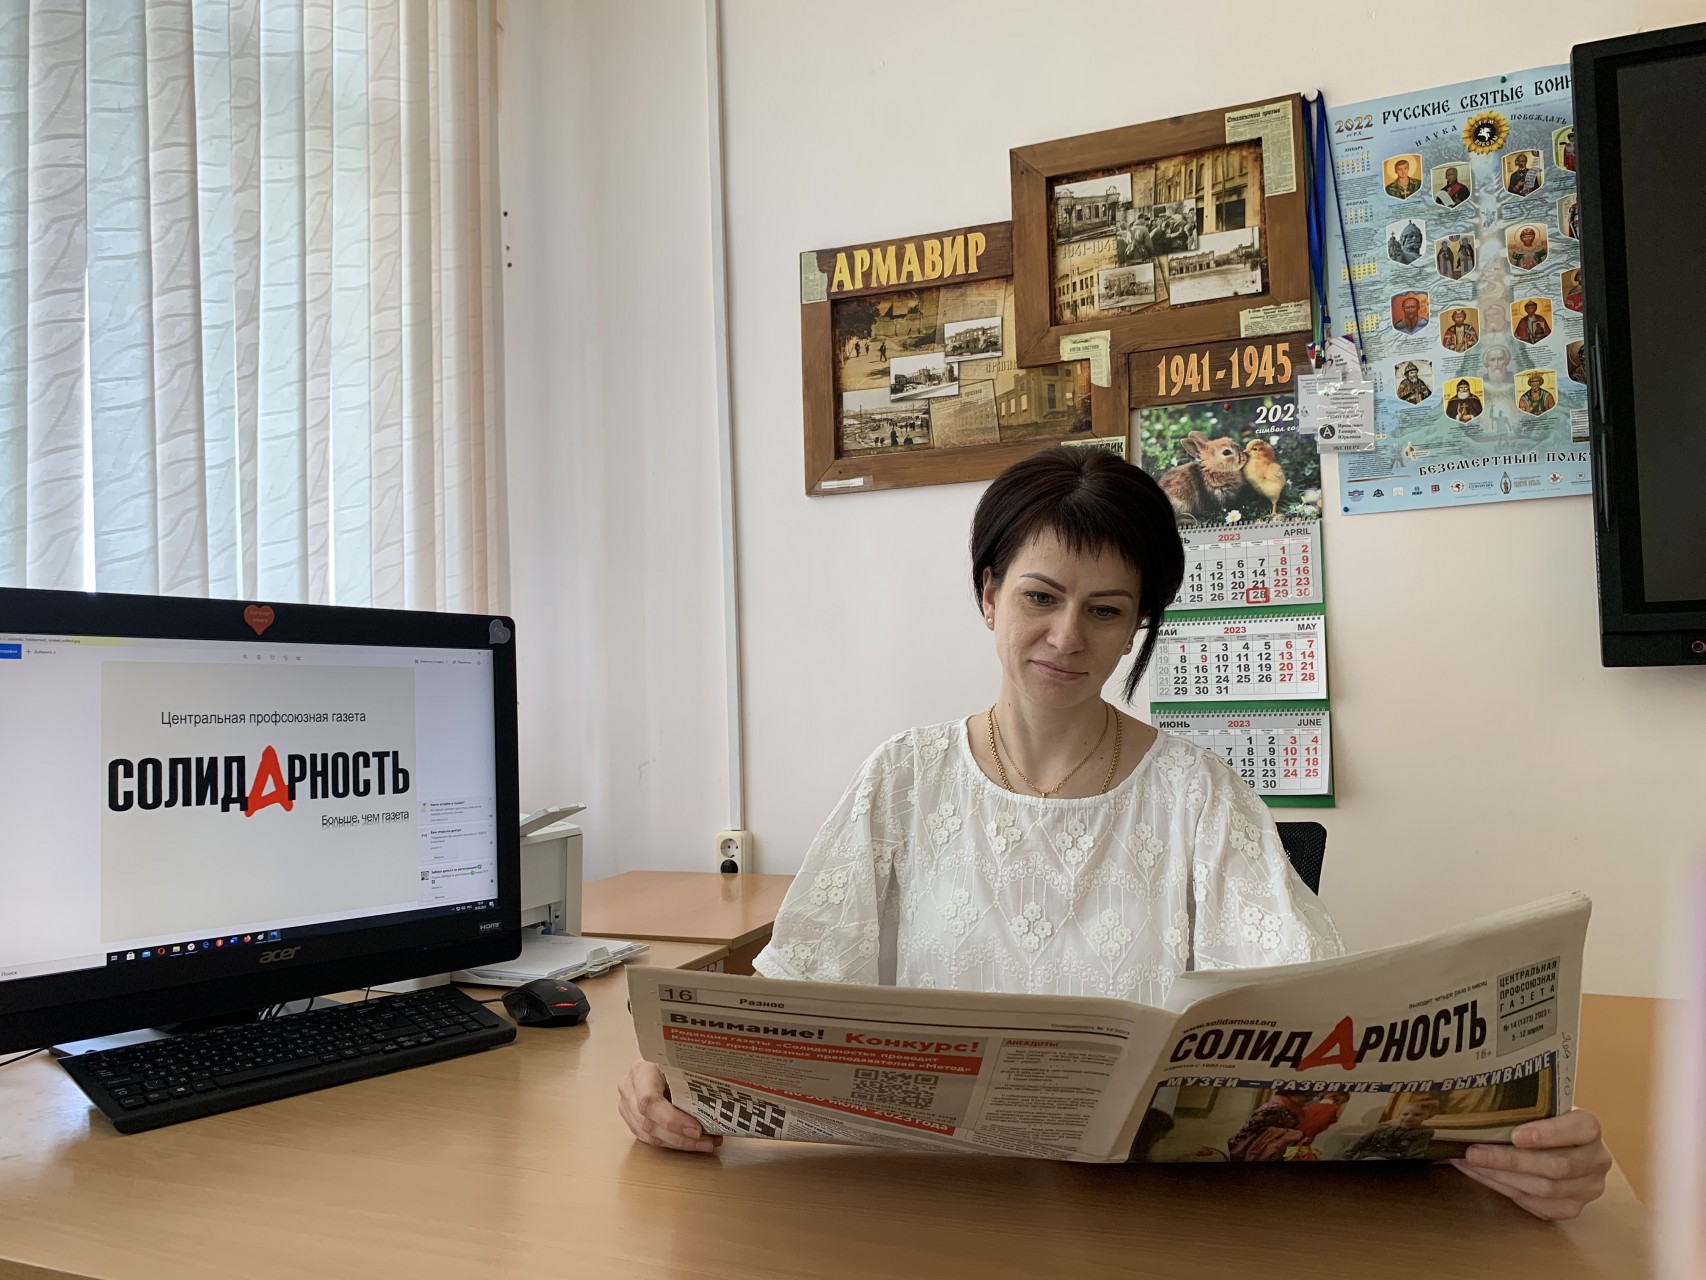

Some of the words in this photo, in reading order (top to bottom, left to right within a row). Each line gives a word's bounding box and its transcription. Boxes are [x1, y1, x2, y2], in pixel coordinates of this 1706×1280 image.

[1383, 100, 1450, 124] РУССКИЕ
[1460, 85, 1524, 110] СВЯТЫЕ
[1335, 115, 1373, 134] 2022
[1510, 113, 1567, 125] ПОБЕЖДАТЬ
[831, 232, 986, 292] АРМАВИР
[1157, 343, 1292, 397] 1941-1945
[1255, 426, 1285, 434] символ
[1418, 451, 1538, 476] БЕЗСМЕРТНЫЙ
[1546, 451, 1591, 462] ПОЛК
[1284, 528, 1311, 536] APRIL
[1280, 546, 1285, 554] 1
[1302, 544, 1308, 553] 2
[1216, 561, 1223, 569] 5
[1237, 560, 1244, 568] 6
[1258, 558, 1265, 566] 7
[1280, 557, 1287, 565] 8
[1189, 573, 1201, 581] 11
[1210, 572, 1223, 580] 12
[1231, 571, 1244, 579] 13
[1252, 569, 1266, 577] 14
[1274, 568, 1287, 576] 15
[1296, 566, 1309, 574] 16
[1190, 584, 1202, 592] 18
[1210, 582, 1224, 590] 19
[1231, 581, 1245, 590] 20
[1252, 580, 1265, 589] 21
[1274, 578, 1288, 587] 22
[1296, 577, 1310, 586] 23
[1190, 594, 1203, 602] 25
[1210, 593, 1224, 601] 26
[1232, 592, 1245, 600] 27
[1252, 591, 1266, 599] 28
[1274, 589, 1288, 597] 29
[1201, 644, 1207, 652] 2
[1222, 643, 1228, 651] 3
[1242, 642, 1250, 650] 4
[1264, 642, 1271, 650] 5
[1286, 641, 1292, 649] 6
[1307, 640, 1314, 648] 7
[1180, 655, 1186, 663] 8
[1201, 654, 1207, 662] 9
[1215, 654, 1228, 662] 10
[1236, 653, 1248, 661] 11
[1258, 652, 1271, 660] 12
[1279, 652, 1293, 660] 13
[1301, 651, 1314, 659] 14
[1174, 666, 1187, 674] 15
[1194, 665, 1208, 673] 16
[1236, 664, 1250, 672] 18
[1258, 663, 1271, 671] 19
[1279, 663, 1293, 671] 20
[1301, 662, 1313, 670] 21
[1174, 676, 1187, 684] 22
[1195, 676, 1208, 684] 23
[1216, 675, 1230, 683] 24
[1237, 675, 1250, 683] 25
[1258, 674, 1272, 682] 26
[1280, 673, 1293, 682] 27
[1301, 673, 1315, 681] 28
[161, 711, 246, 727] Центральная
[249, 710, 328, 726] профсоюзная
[332, 711, 366, 723] газета
[1247, 736, 1252, 744] 1
[1268, 736, 1275, 744] 2
[1290, 736, 1296, 744] 3
[1312, 736, 1318, 744] 4
[1226, 748, 1232, 756] 7
[1247, 747, 1254, 755] 8
[1269, 747, 1275, 755] 9
[1283, 747, 1297, 755] 10
[1305, 747, 1317, 755] 11
[1241, 758, 1254, 766] 15
[1262, 758, 1276, 766] 16
[1284, 758, 1297, 766] 17
[1305, 758, 1318, 766] 18
[108, 745, 410, 818] СОЛИДАРНОСТЬ
[1262, 780, 1276, 788] 30
[362, 814, 380, 824] чем
[382, 810, 409, 823] газета
[259, 946, 301, 963] acer
[1500, 960, 1557, 988] ЦЕНТРАЛЬНАЯ
[1500, 972, 1556, 1000] ПРОФСОЮЗНАЯ
[664, 988, 693, 1001] 16
[1500, 984, 1555, 1012] ГАЗЕТА
[740, 998, 785, 1008] Разное
[670, 1013, 825, 1040] Внимание!
[845, 1032, 979, 1053] Конкурс!
[1183, 1019, 1277, 1034] www.solidarnost.org
[1170, 1000, 1487, 1072] СОЛИДАРНОСТЬ
[671, 1028, 728, 1041] Редакция
[731, 1037, 770, 1046] газеты
[776, 1042, 876, 1057] «Солидарность»
[881, 1053, 938, 1063] проводит
[671, 1035, 721, 1046] Конкурс
[727, 1042, 811, 1057] профсоюзных
[816, 1053, 915, 1068] преподавателей
[919, 1063, 971, 1072] «Метод»
[1166, 1076, 1240, 1088] МУЗЕИ
[1270, 1079, 1382, 1093] РАЗВИТИЕ
[1391, 1079, 1433, 1093] ИЛИ
[1442, 1051, 1552, 1092] ВЫЖИВАНИЕ
[914, 1118, 949, 1131] года
